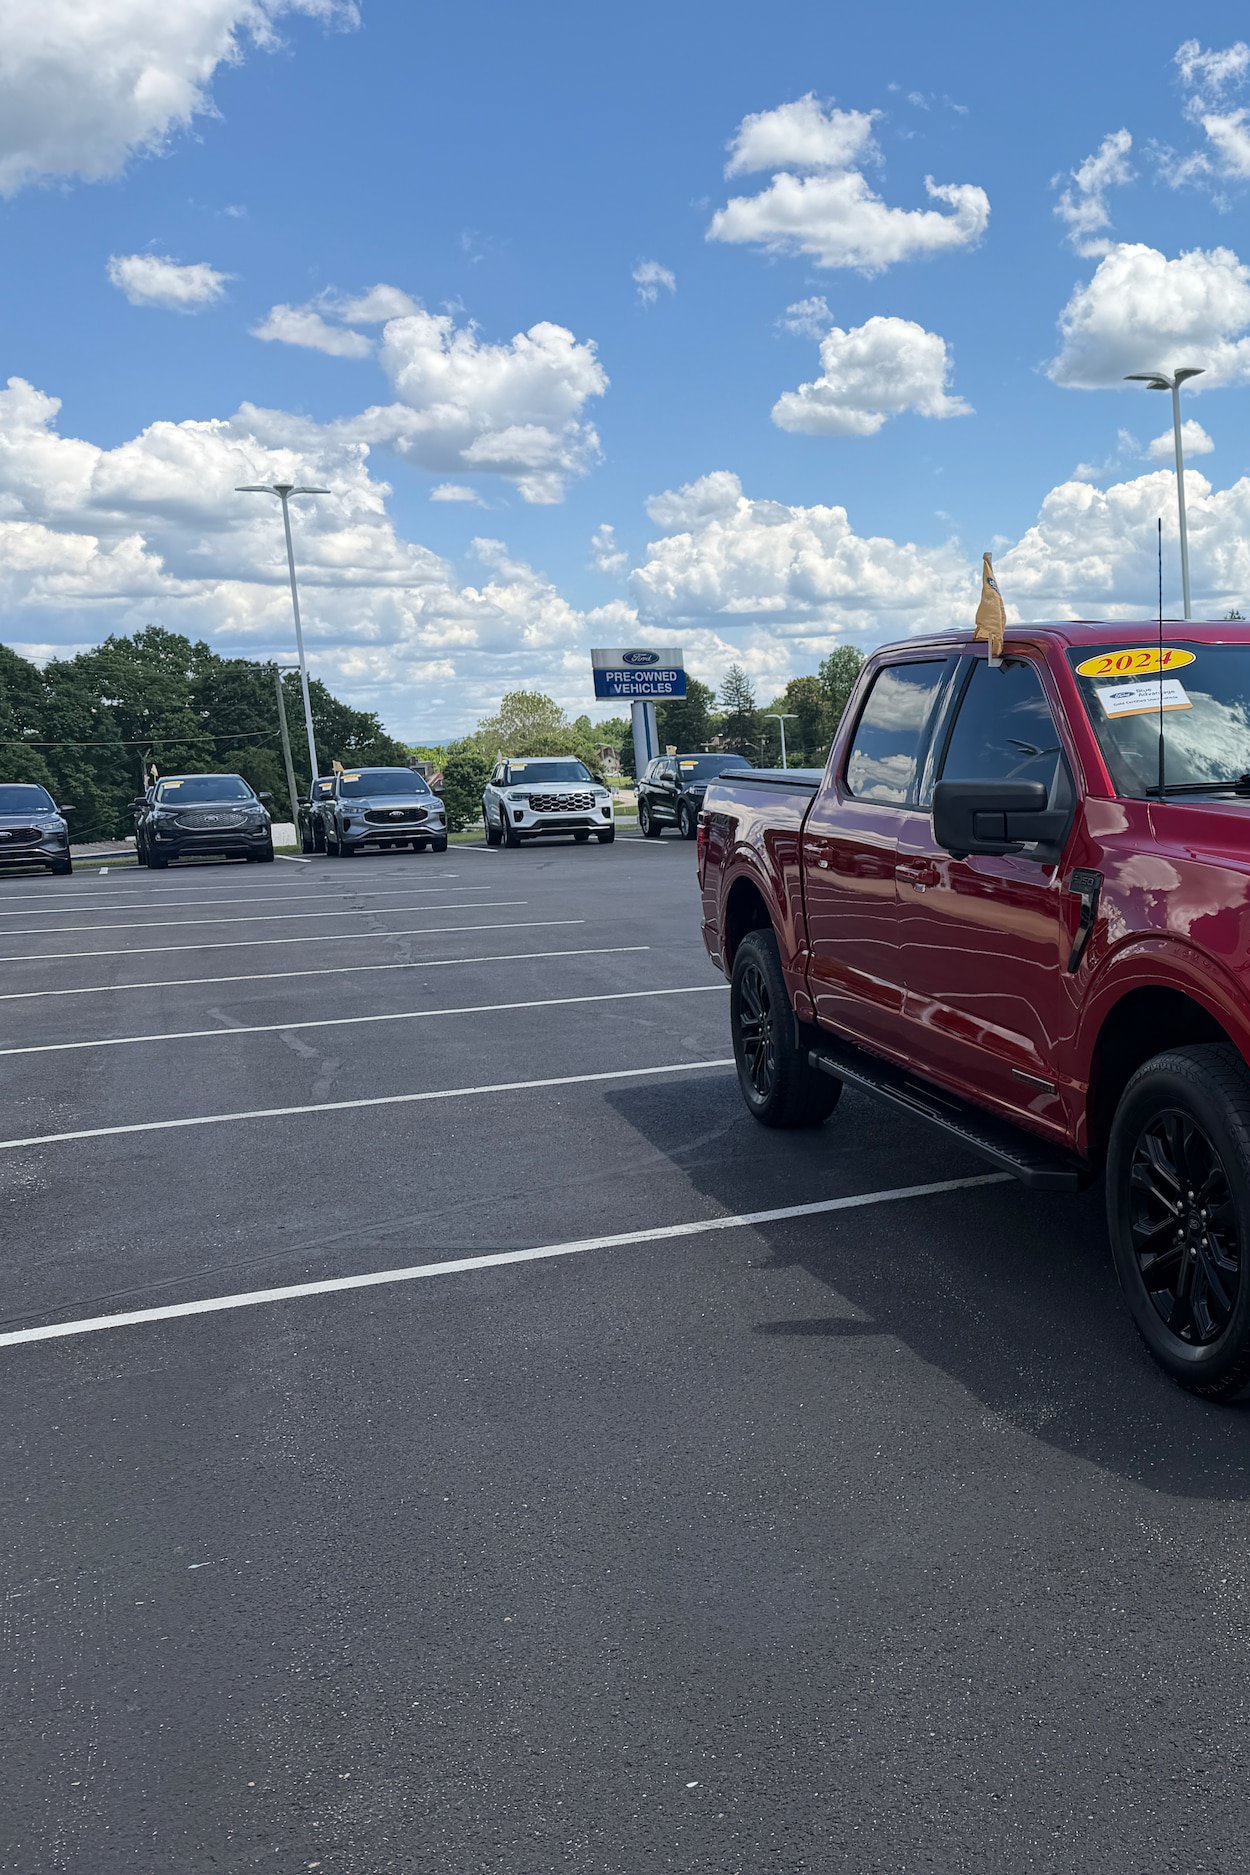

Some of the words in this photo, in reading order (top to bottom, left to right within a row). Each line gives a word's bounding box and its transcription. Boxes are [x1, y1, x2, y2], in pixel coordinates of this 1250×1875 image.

[631, 653, 652, 662] Ford
[1096, 650, 1173, 674] 2024
[605, 671, 677, 682] PRE-OWNED
[613, 683, 672, 693] VEHICLES
